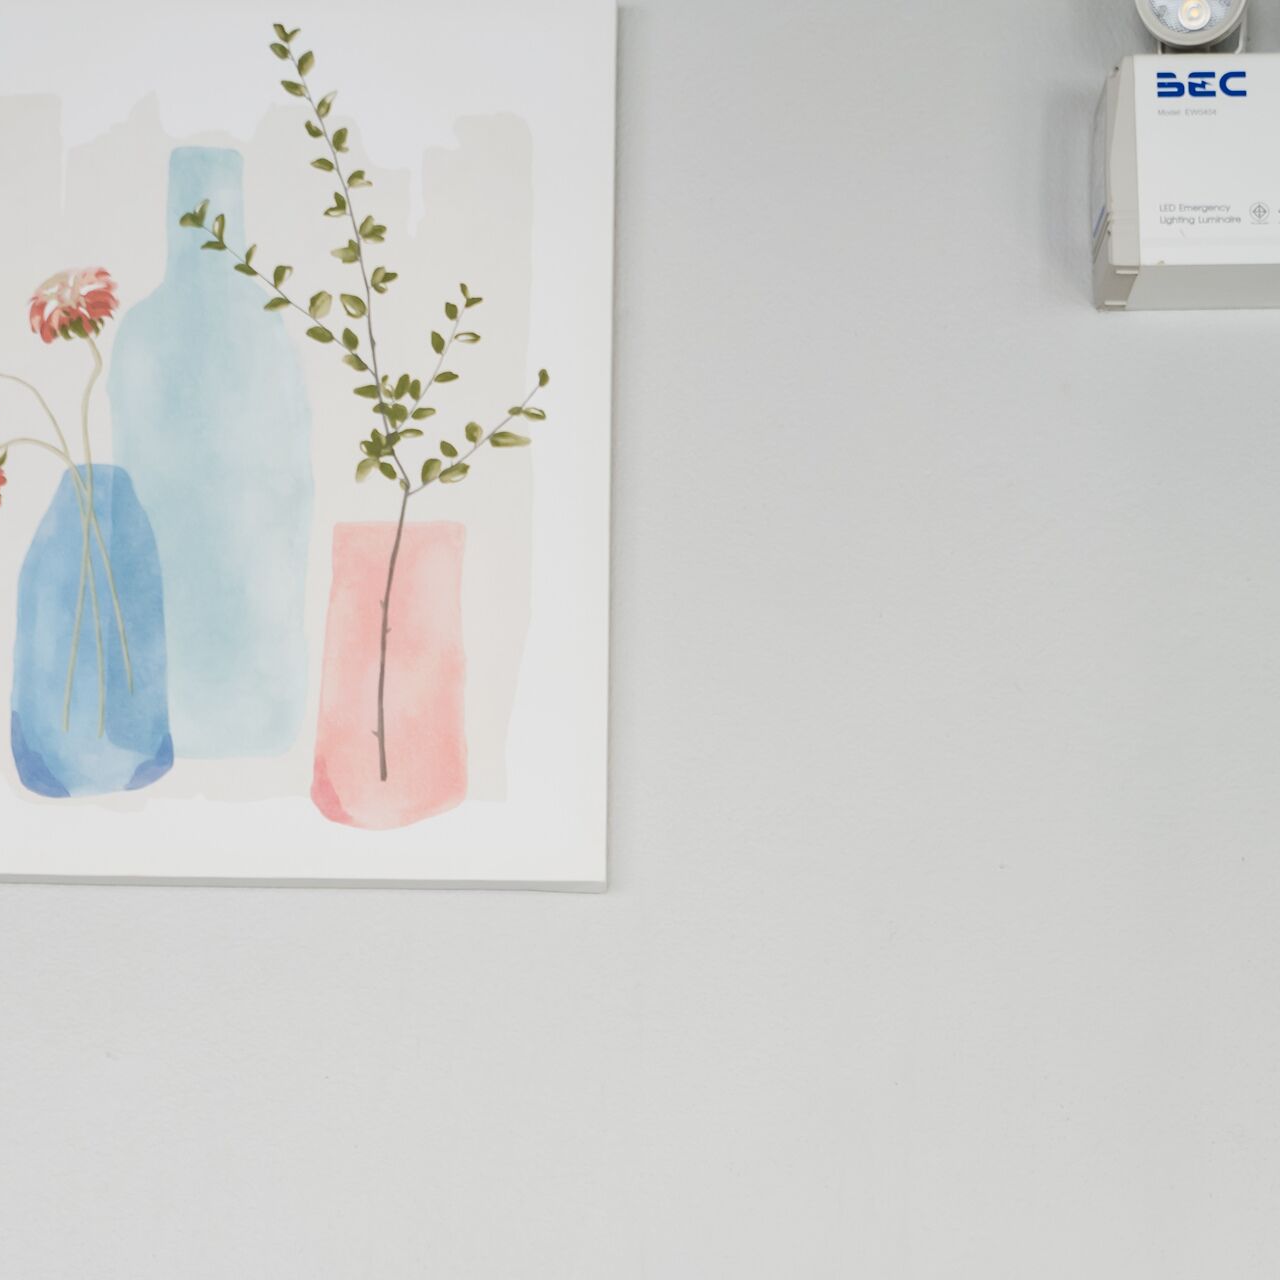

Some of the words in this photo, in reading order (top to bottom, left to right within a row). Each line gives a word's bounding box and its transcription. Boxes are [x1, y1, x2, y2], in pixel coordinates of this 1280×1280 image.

[1160, 203, 1176, 213] LED
[1179, 203, 1231, 214] Emergency
[1160, 215, 1195, 225] Lighting
[1198, 215, 1242, 224] Luminaire
